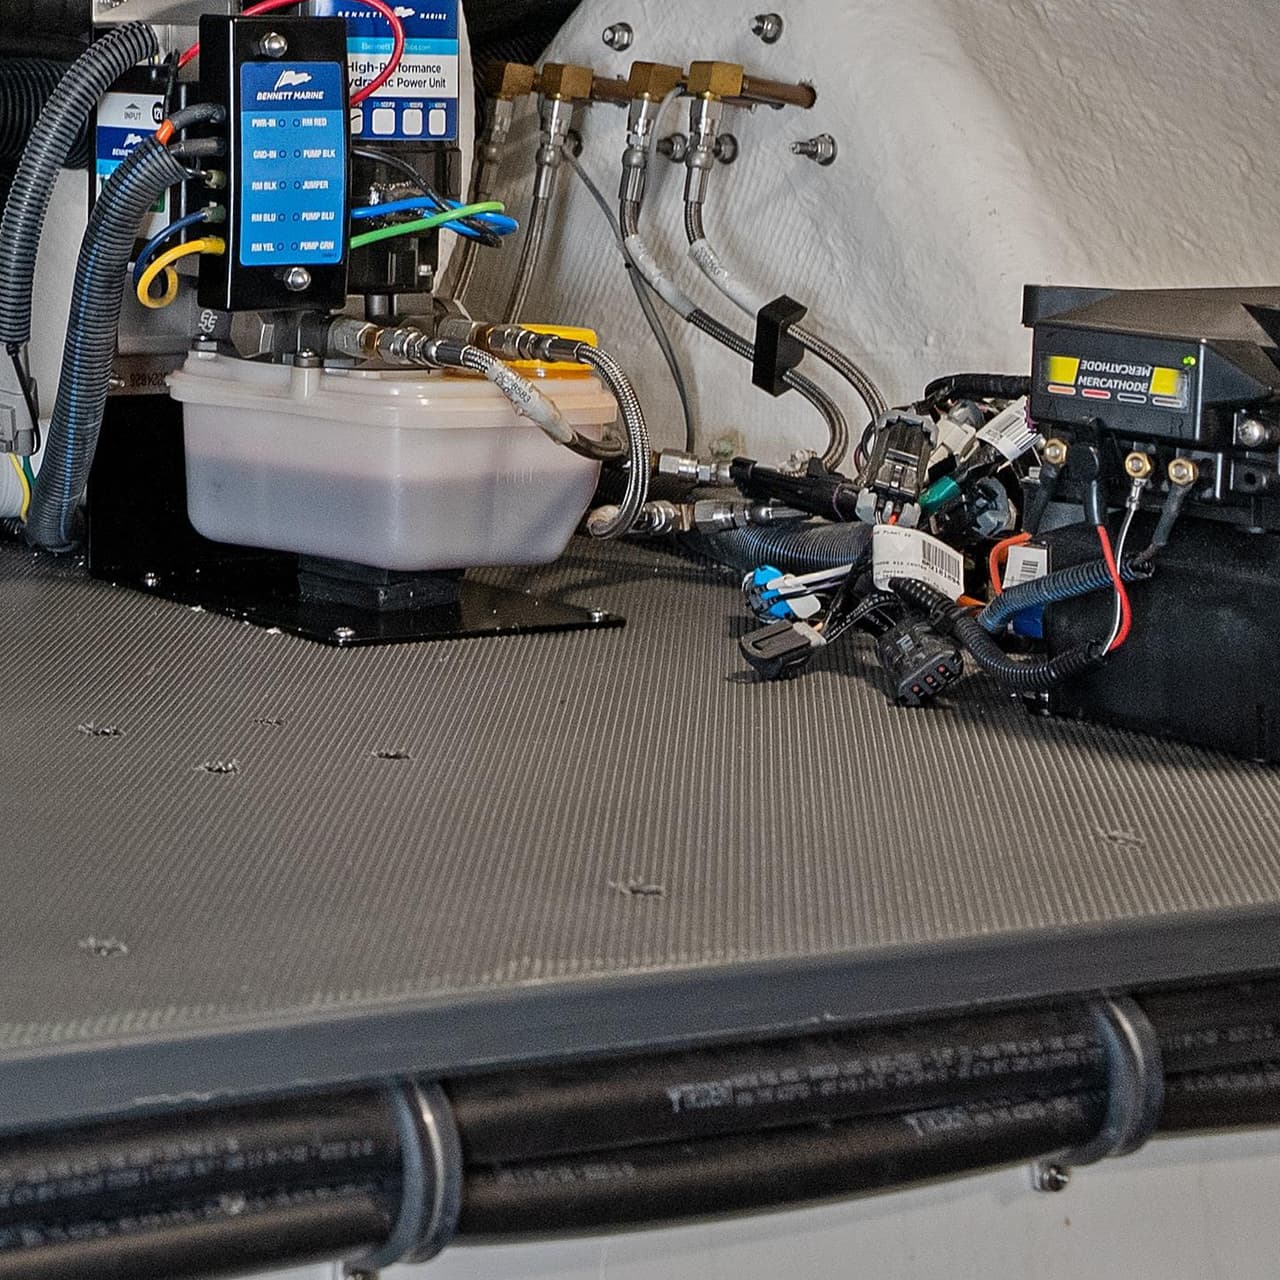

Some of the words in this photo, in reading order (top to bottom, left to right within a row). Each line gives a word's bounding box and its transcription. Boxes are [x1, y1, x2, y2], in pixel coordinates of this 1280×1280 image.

[397, 78, 427, 88] Power
[429, 78, 446, 88] Unit
[256, 91, 293, 101] BENNETT
[293, 91, 324, 100] MARINE
[314, 118, 327, 126] RED
[303, 149, 321, 158] PUMP
[322, 149, 336, 158] BLK
[263, 181, 277, 190] BLK
[302, 180, 328, 190] JUMPER
[263, 213, 276, 222] BLU
[301, 212, 320, 221] PUMP
[321, 212, 335, 220] BLU
[262, 242, 274, 252] YEL
[300, 241, 319, 250] PUMP
[320, 241, 335, 250] GRN
[1080, 359, 1152, 377] MERCATHODE
[1078, 375, 1150, 393] MERCATHODE
